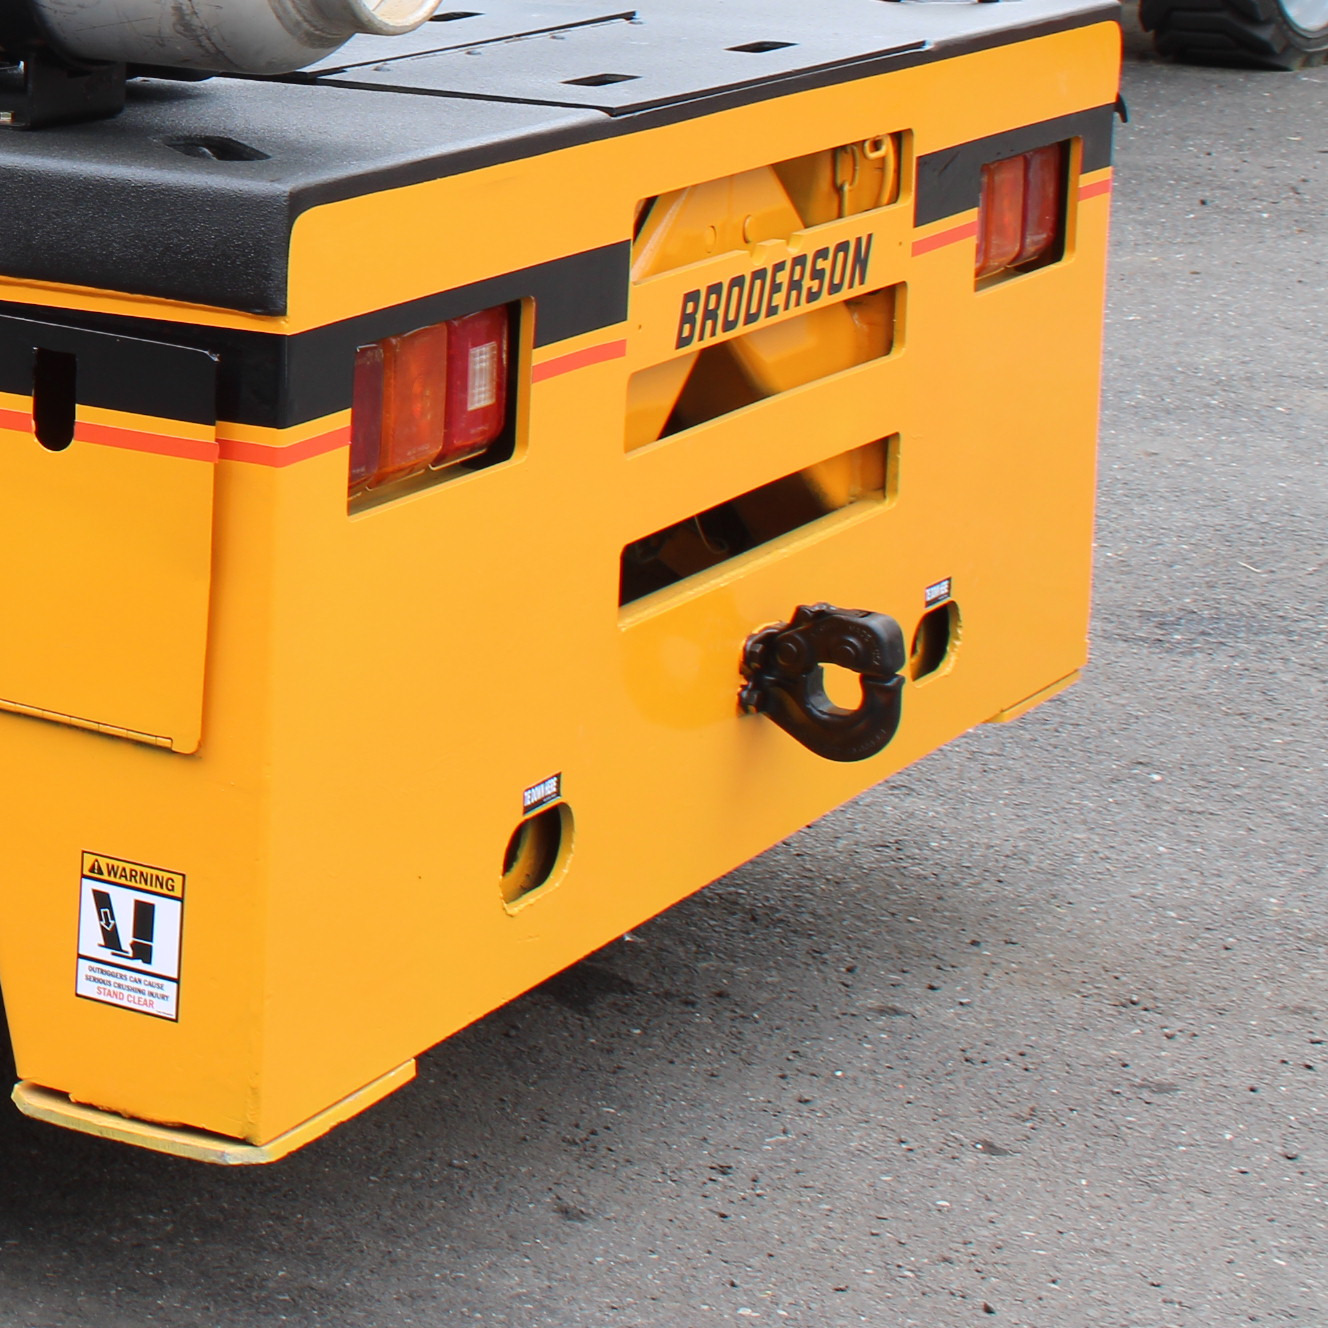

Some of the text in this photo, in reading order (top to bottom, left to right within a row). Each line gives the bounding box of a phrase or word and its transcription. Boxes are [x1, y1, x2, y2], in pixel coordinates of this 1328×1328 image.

[675, 233, 874, 351] BRODERSON
[106, 862, 176, 893] WARNING
[85, 974, 170, 1002] SERIOUS CRUSHING INJURY
[88, 964, 165, 991] OUTRIGGERS CAN CAUSE
[96, 985, 155, 1009] STAND CLEAR
